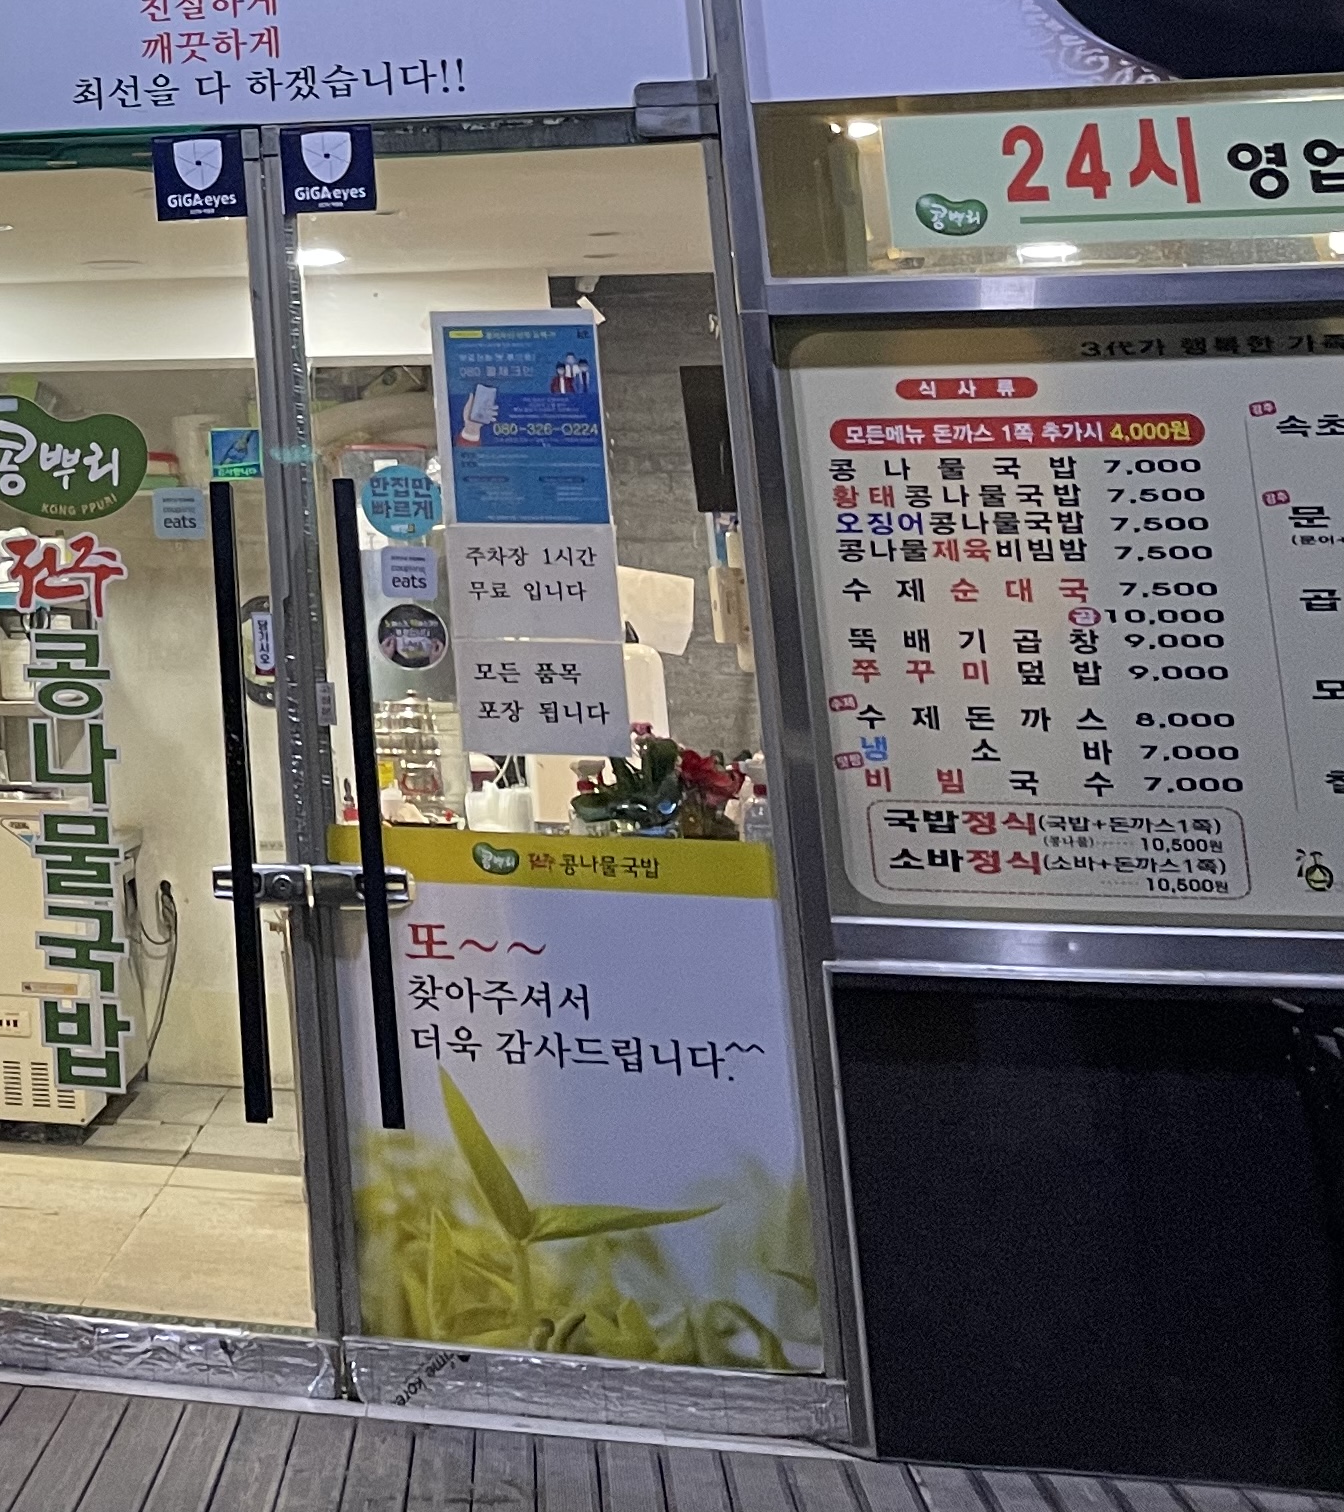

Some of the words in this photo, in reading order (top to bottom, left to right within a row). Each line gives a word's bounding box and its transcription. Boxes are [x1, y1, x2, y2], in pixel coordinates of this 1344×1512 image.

[141, 26, 282, 65] 깨끗하게
[72, 73, 181, 110] 최선을
[194, 67, 231, 105] 다
[247, 58, 467, 102] 하겠습니다!!
[1002, 116, 1202, 205] 24시
[845, 421, 926, 446] 모든메뉴
[932, 420, 995, 444] 돈까스
[1002, 419, 1034, 443] 1쪽
[1040, 419, 1104, 444] 추가시
[1110, 419, 1191, 443] 4,000원
[41, 502, 76, 516] KONG
[81, 493, 118, 514] PPURI
[163, 514, 197, 529] eats
[465, 546, 530, 568] 주차장
[541, 546, 599, 569] 1시간
[2, 532, 128, 622] 전주
[392, 574, 428, 589] eats
[468, 580, 512, 602] 무료
[522, 581, 588, 603] 입니다
[473, 663, 522, 684] 모든
[533, 661, 582, 686] 품목
[477, 700, 524, 723] 포장
[537, 701, 611, 726] 됩니다
[23, 627, 133, 1094] 콩나물국밥
[559, 853, 660, 880] 콩나물국밥
[407, 974, 591, 1022] 찾아주셔서
[410, 1023, 483, 1063] 더욱
